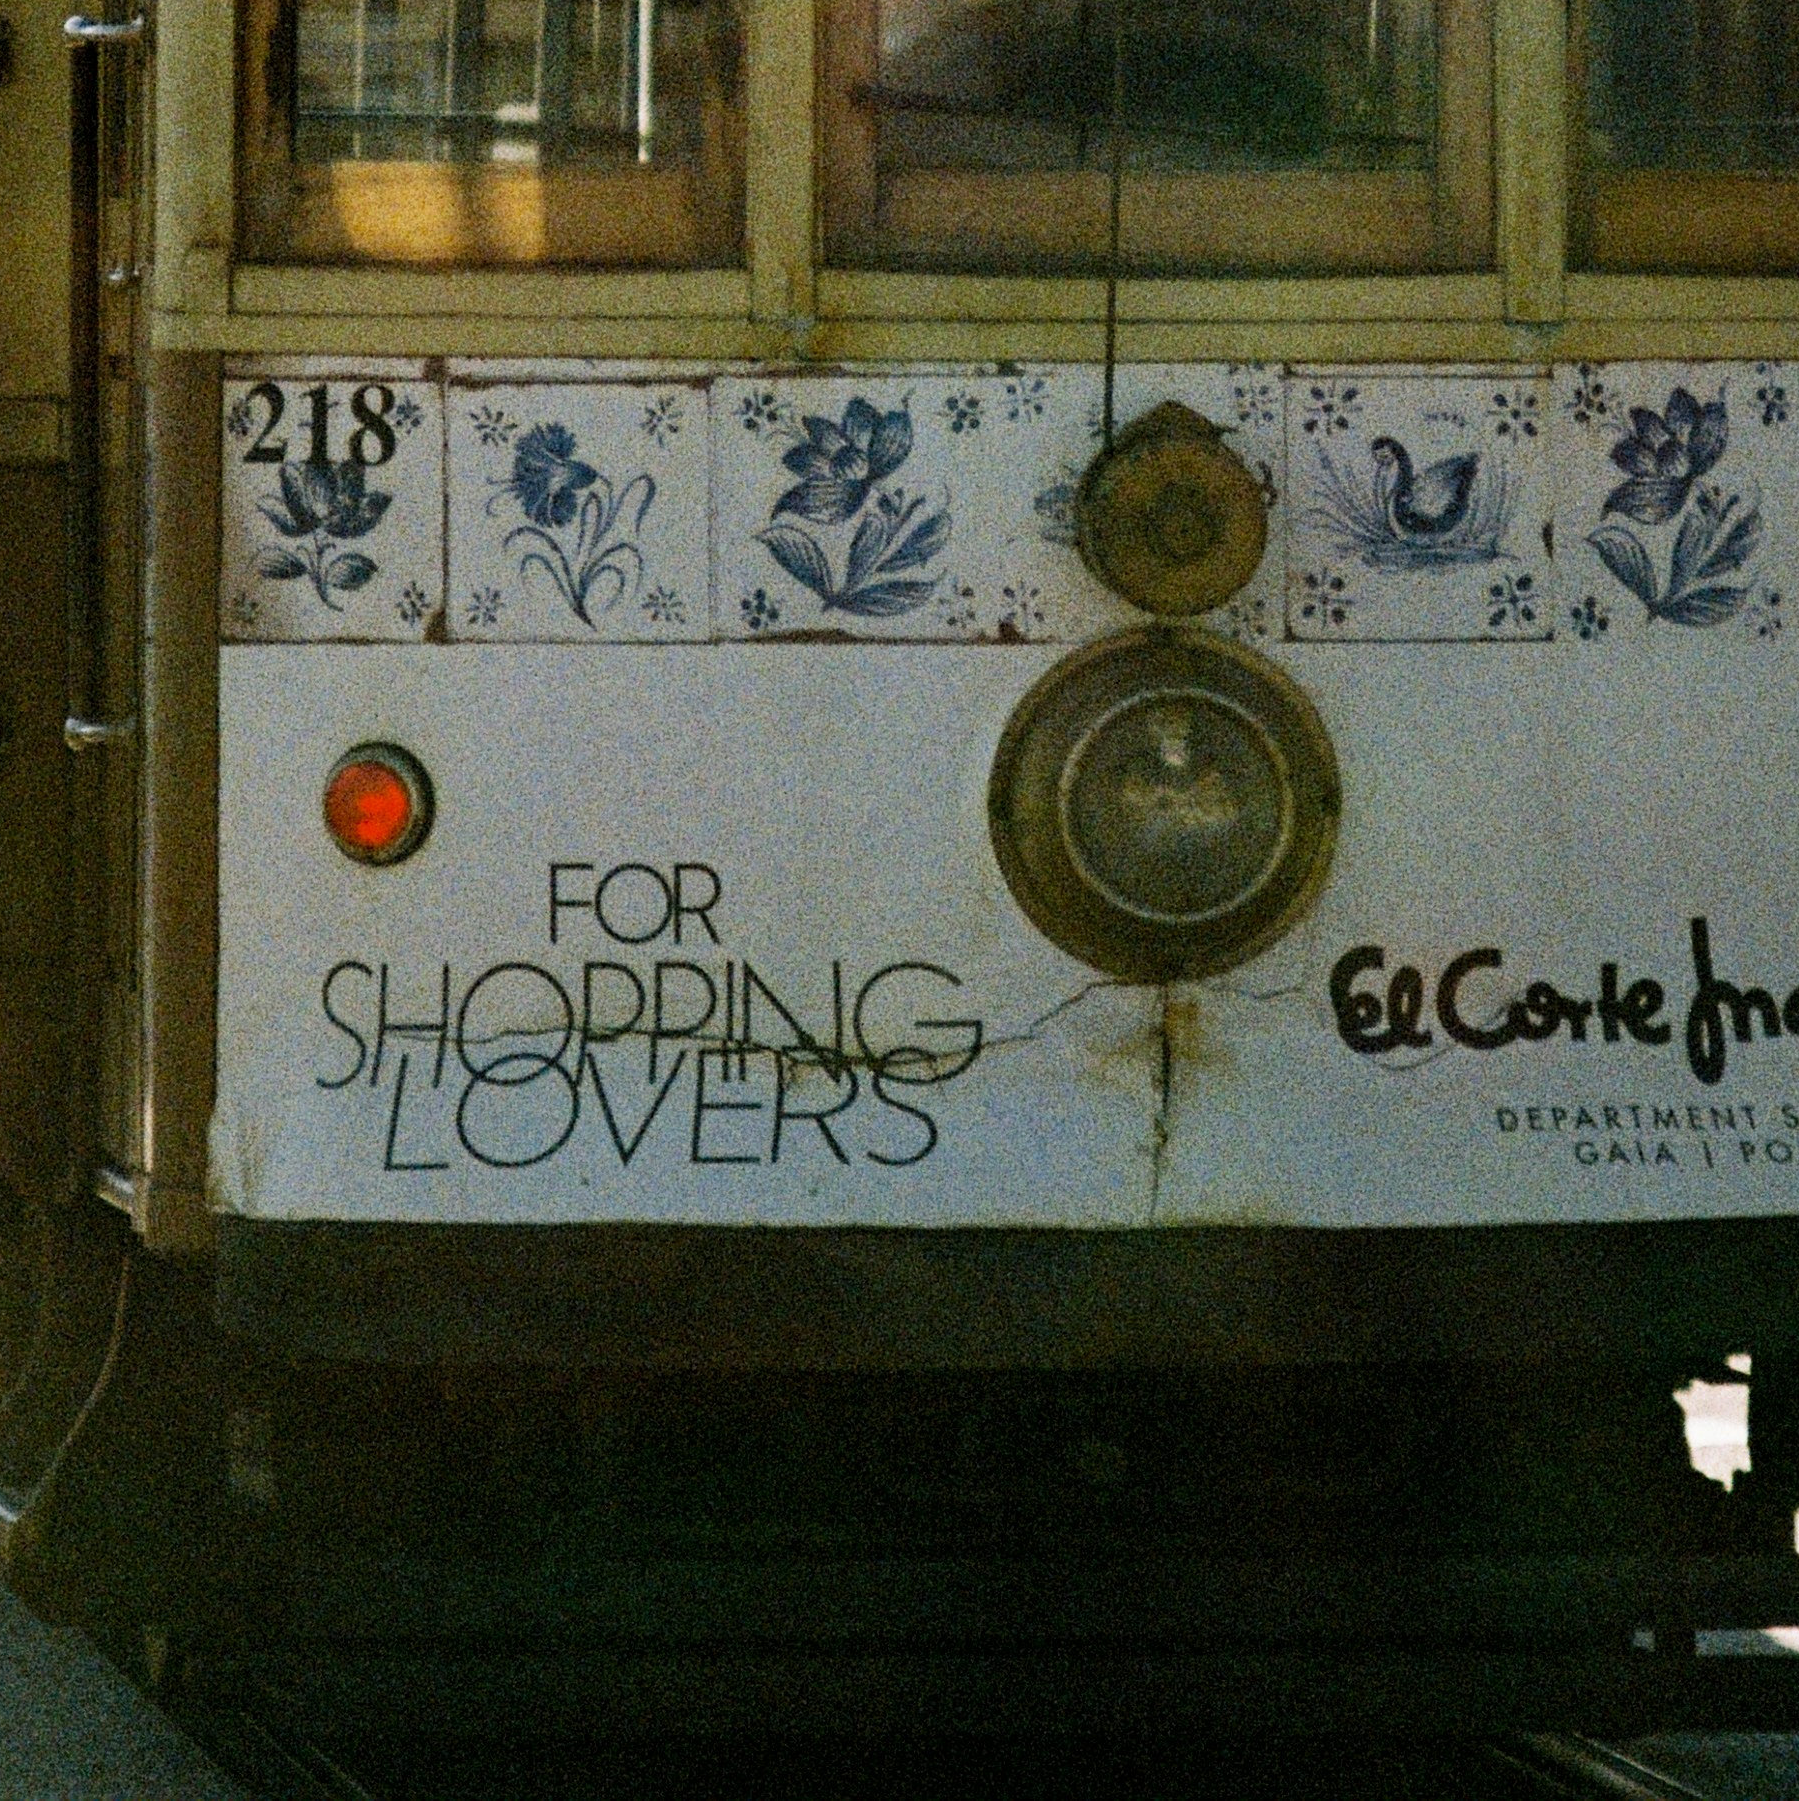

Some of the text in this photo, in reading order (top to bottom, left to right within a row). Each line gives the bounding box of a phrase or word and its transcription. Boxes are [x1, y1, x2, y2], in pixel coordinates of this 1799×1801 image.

[241, 381, 399, 467] 218
[548, 861, 724, 945] FOR
[315, 959, 985, 1089] SHOPPING
[1328, 943, 1433, 1055] El
[1435, 945, 1672, 1051] Corte
[383, 1047, 939, 1170] LOVERS
[1497, 1102, 1757, 1134] DEPARTMENT
[1574, 1139, 1675, 1167] GAIA
